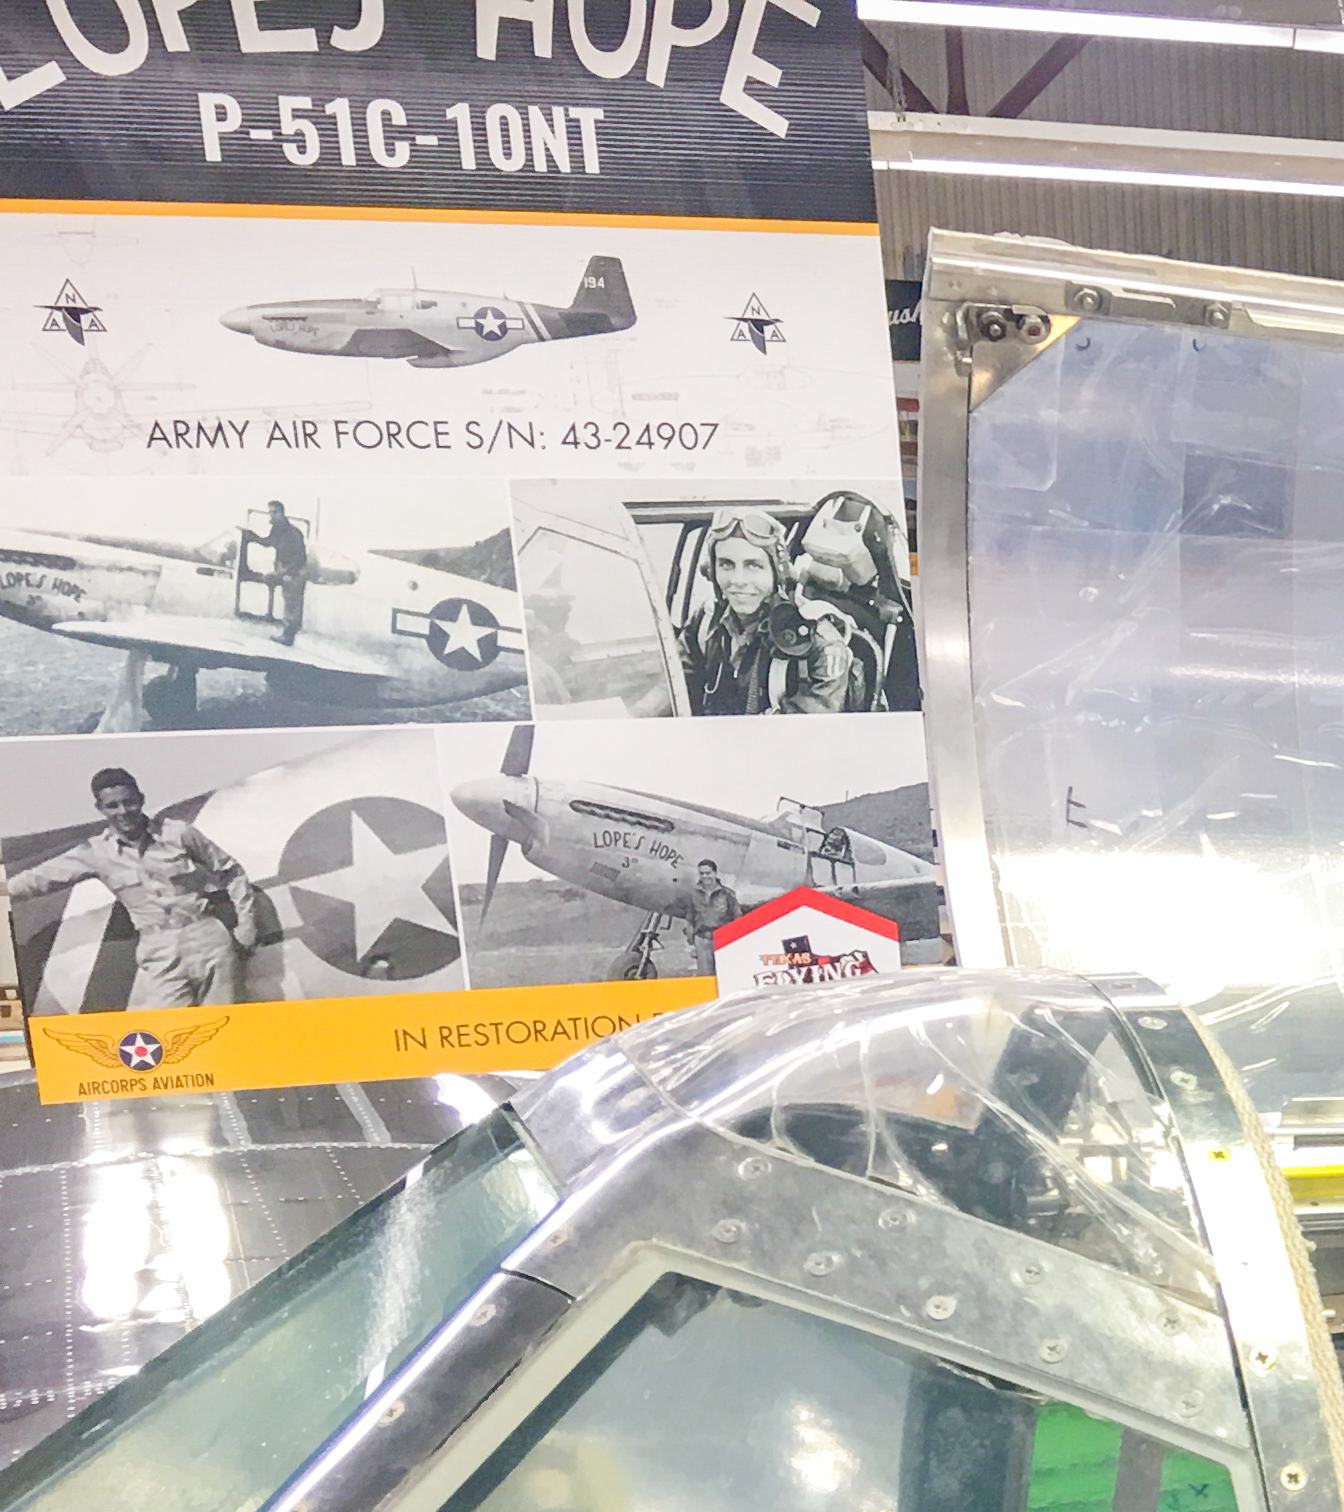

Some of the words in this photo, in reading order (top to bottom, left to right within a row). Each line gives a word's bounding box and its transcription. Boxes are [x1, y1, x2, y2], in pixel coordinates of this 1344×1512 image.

[198, 92, 604, 174] P-51C-10NT
[584, 277, 605, 288] 194
[146, 420, 250, 449] ARMY
[266, 420, 321, 449] AIR
[333, 420, 451, 449] FORCE
[465, 419, 546, 454] S/N:
[561, 421, 719, 450] 43-24907
[649, 840, 684, 869] HOPE
[759, 953, 812, 966] TEXAS
[394, 1028, 427, 1051] IN
[78, 1077, 147, 1096] AIRCORPS
[152, 1073, 214, 1090] AVIATION
